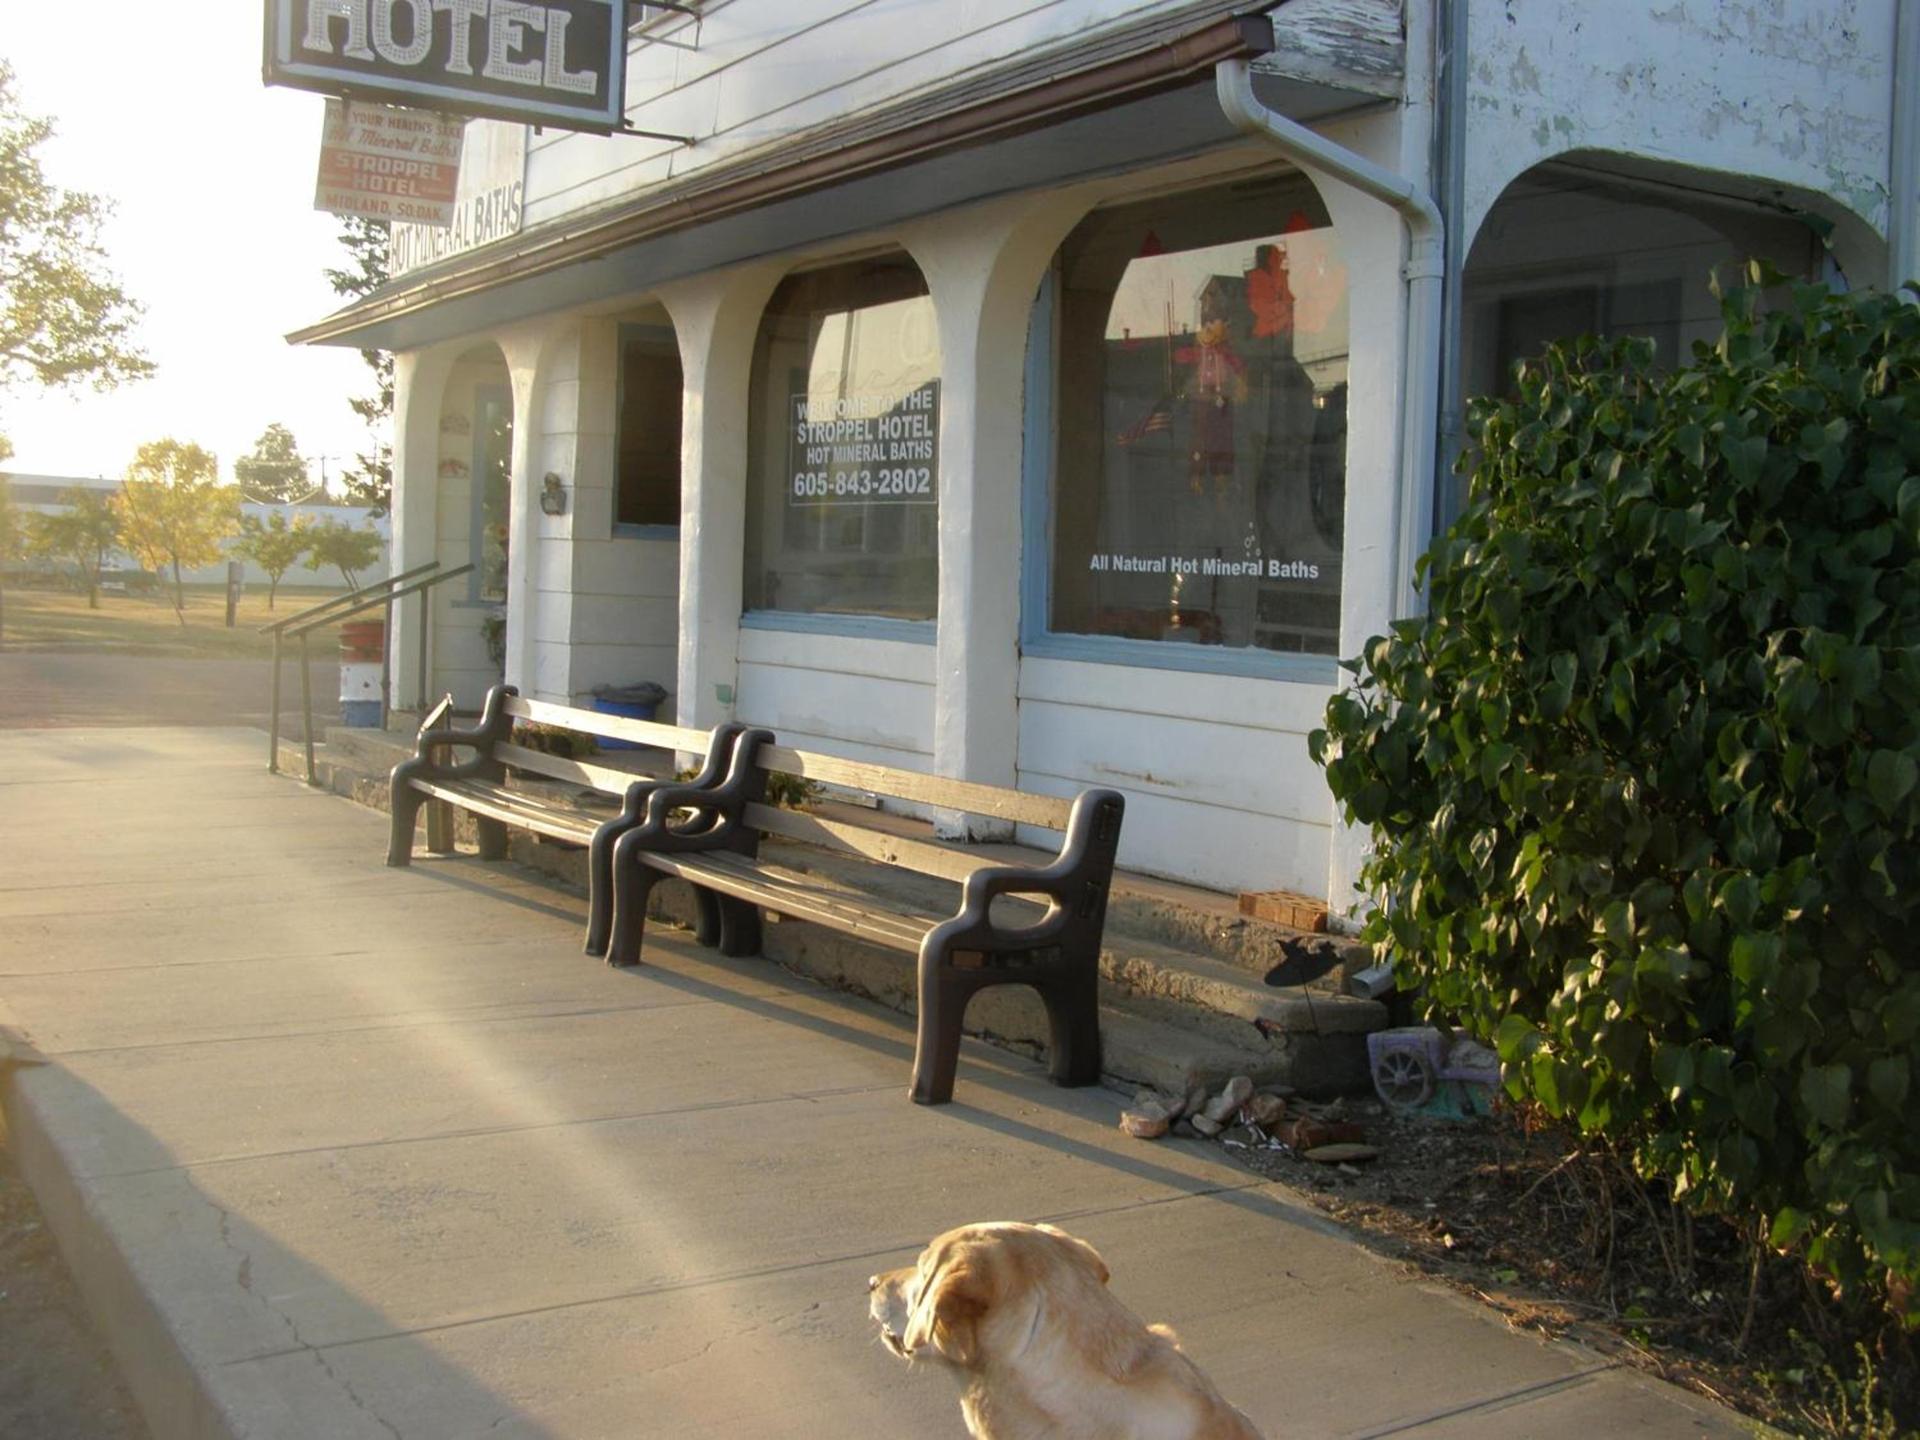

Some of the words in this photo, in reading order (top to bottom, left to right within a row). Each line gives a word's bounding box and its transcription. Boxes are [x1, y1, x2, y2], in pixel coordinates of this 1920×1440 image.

[301, 0, 598, 95] HOTEL
[358, 129, 416, 152] Mineral
[336, 153, 441, 182] STROPPEL
[352, 173, 421, 197] HOTEL
[475, 181, 522, 245] BATHS
[901, 390, 932, 411] THE
[797, 419, 873, 444] STROPPEL
[878, 414, 933, 440] HOTEL
[807, 447, 830, 465] HOT
[833, 443, 887, 463] MINERAL
[890, 439, 932, 461] BATHS
[794, 467, 930, 496] 605-843-2802
[1090, 555, 1109, 571] All
[1113, 555, 1166, 573] Natural
[1171, 557, 1199, 574] Hot
[1203, 559, 1263, 576] Mineral
[1268, 559, 1319, 579] Baths
